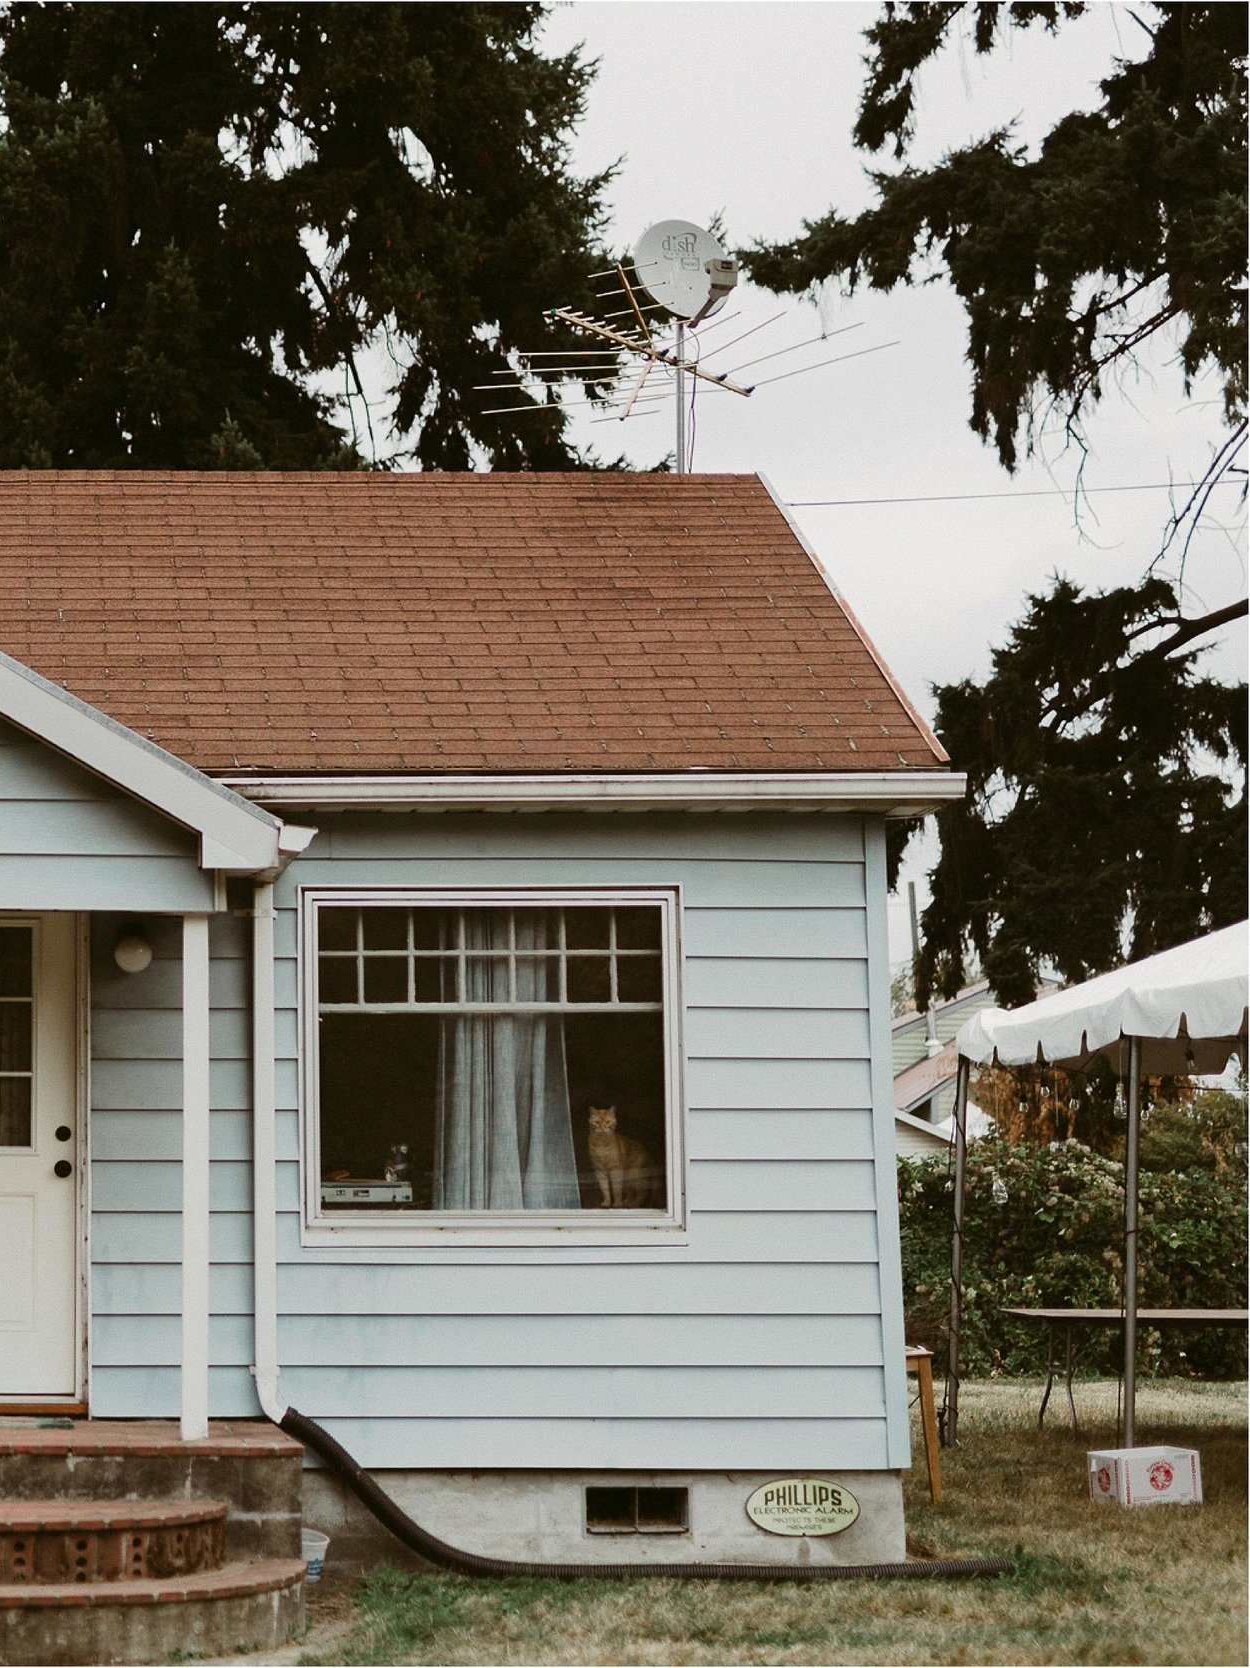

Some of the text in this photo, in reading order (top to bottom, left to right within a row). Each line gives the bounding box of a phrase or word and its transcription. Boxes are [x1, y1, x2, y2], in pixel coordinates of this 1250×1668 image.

[662, 234, 696, 252] dish
[764, 1484, 843, 1506] PHILLIPS
[753, 1506, 854, 1515] ELECTRONIC ALARM
